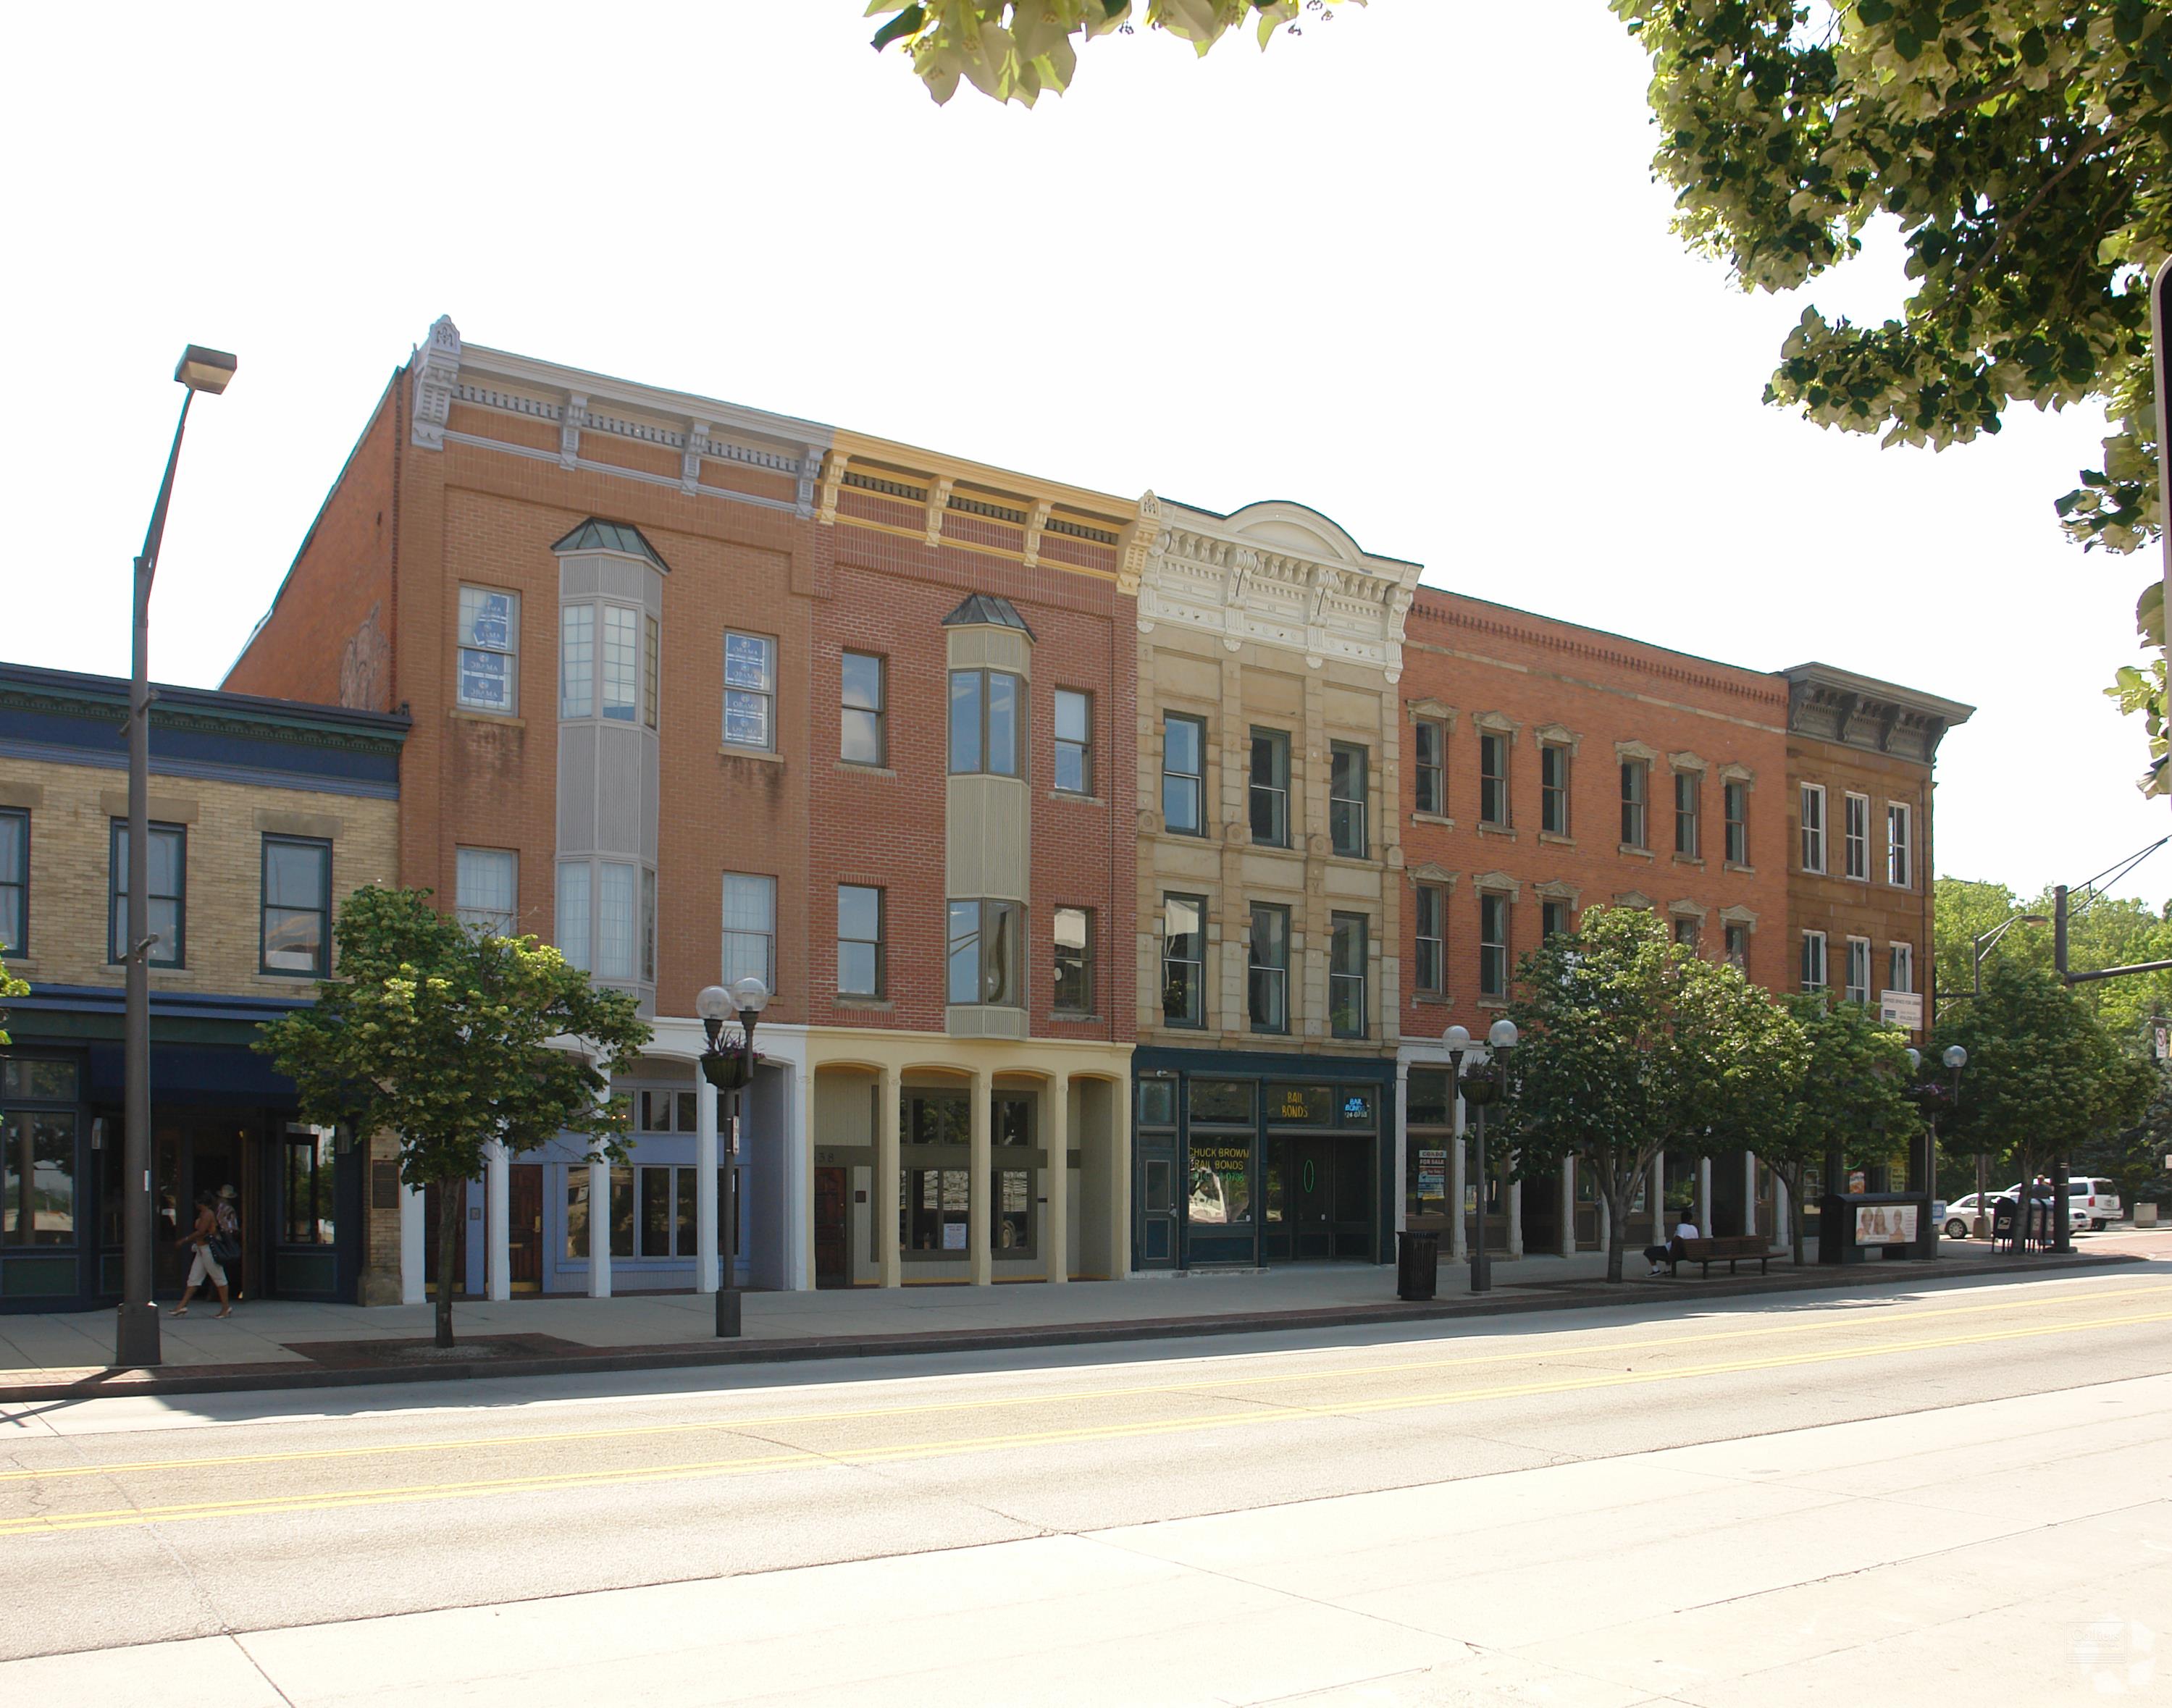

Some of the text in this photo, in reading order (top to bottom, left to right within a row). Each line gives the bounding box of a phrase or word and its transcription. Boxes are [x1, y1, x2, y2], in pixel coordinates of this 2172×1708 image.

[1287, 1091, 1303, 1103] BAIL
[1281, 1105, 1308, 1118] BONDS
[1188, 1147, 1249, 1158] CHUCK BROWN
[1215, 1160, 1244, 1170] BONDS
